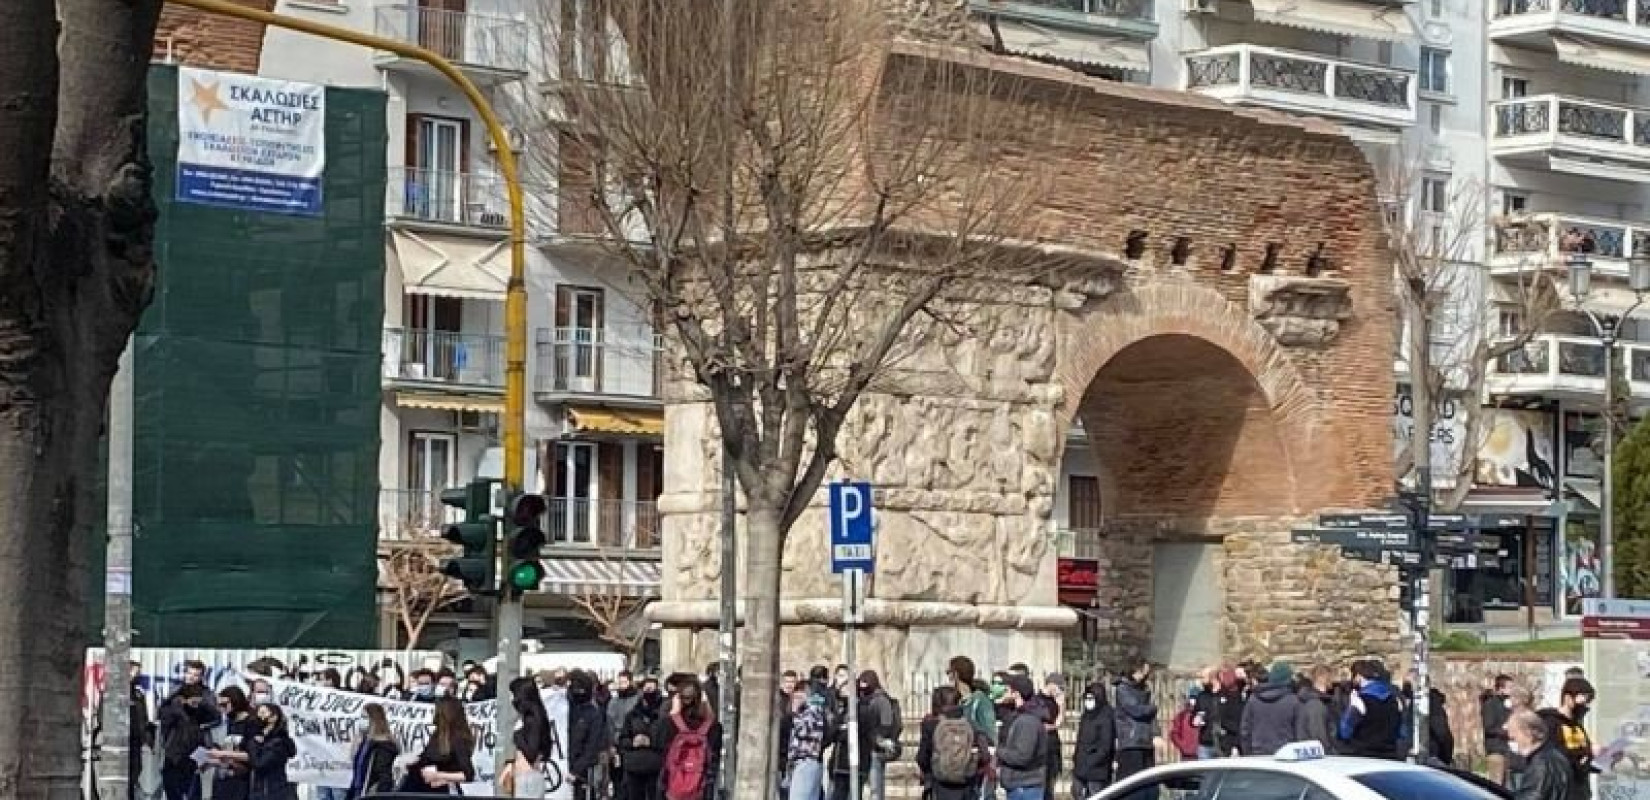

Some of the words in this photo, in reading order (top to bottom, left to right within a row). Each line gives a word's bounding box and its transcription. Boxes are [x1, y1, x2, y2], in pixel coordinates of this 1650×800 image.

[230, 85, 319, 110] ΣΚΑΛΩΣΙΕΣ
[251, 107, 302, 125] ΑΣΤΗΡ
[841, 486, 862, 537] P
[1292, 746, 1322, 759] TAXI
